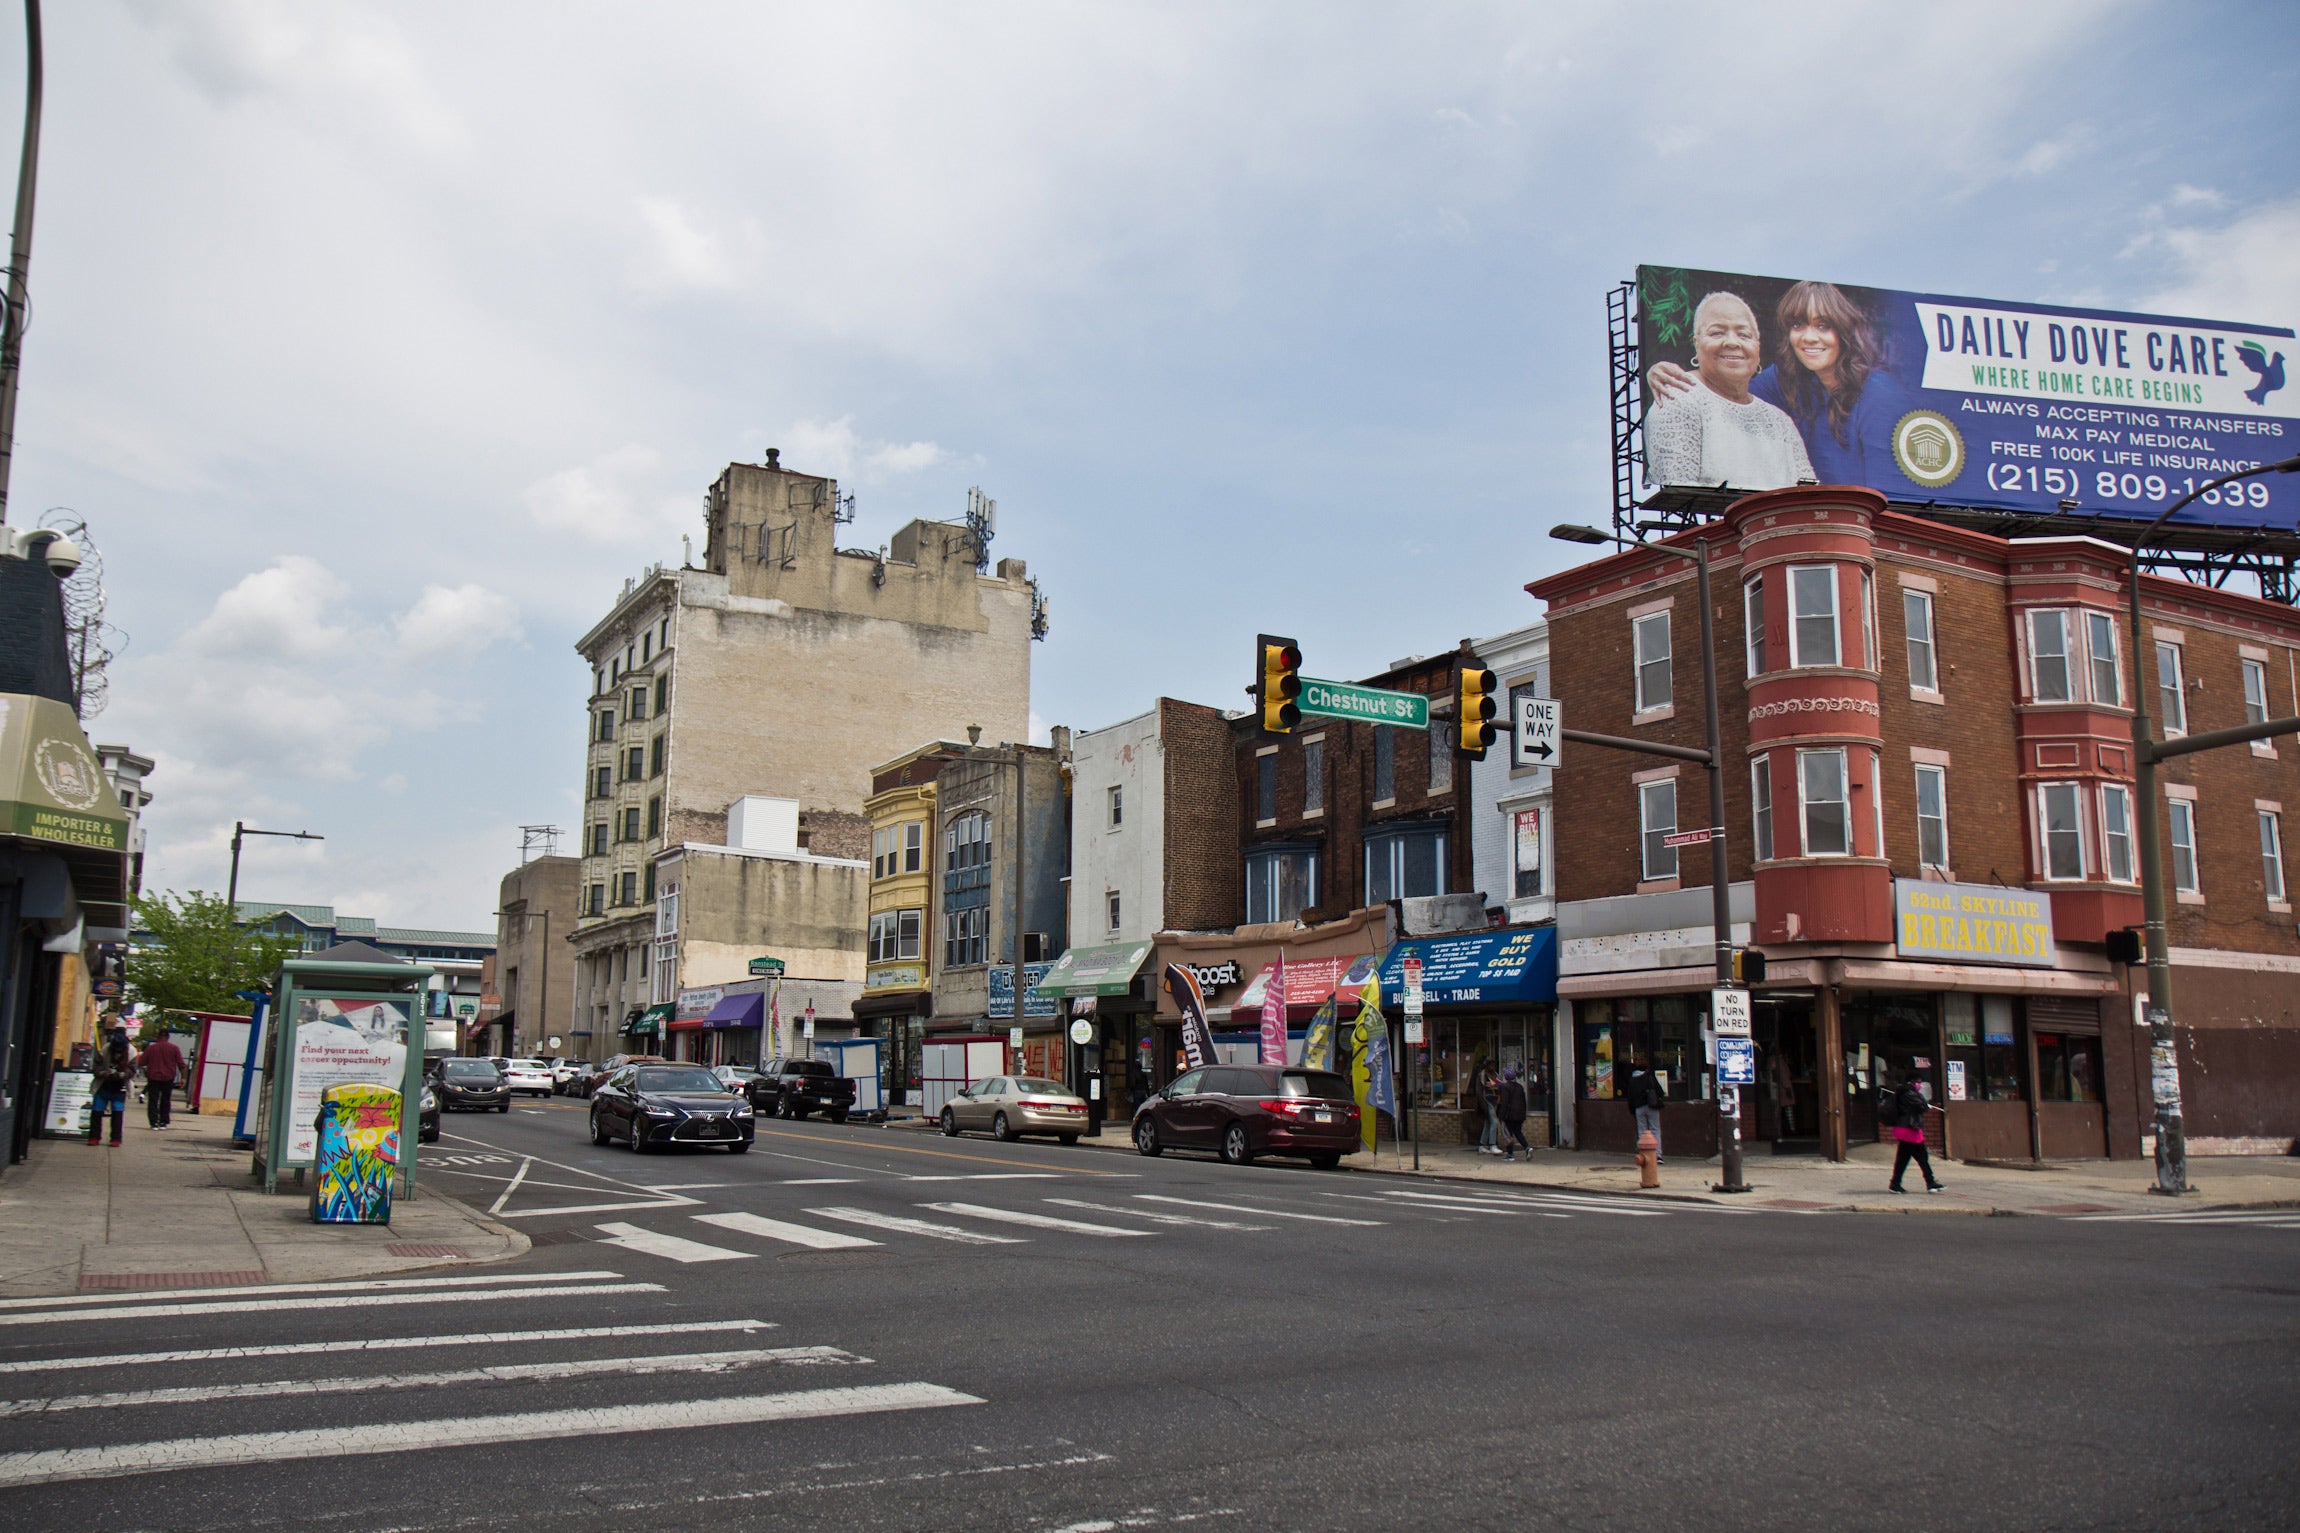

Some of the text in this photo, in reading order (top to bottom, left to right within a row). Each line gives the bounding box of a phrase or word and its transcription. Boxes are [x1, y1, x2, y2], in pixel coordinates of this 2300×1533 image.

[1937, 313, 2228, 376] DAILY DOVE CARE
[1972, 365, 2202, 404] WHERE HOME CARE BEGINS
[1961, 398, 2283, 437] ALWAYS ACCEPTING TRANSFERS
[2035, 425, 2215, 451] MAX PAY MEDICAL
[1991, 441, 2042, 458] FREE
[2050, 446, 2096, 462] 100K
[2103, 450, 2143, 466] LIFE
[1987, 462, 2270, 508] (215) 809-1639
[1307, 686, 1414, 719] Chestnut St
[1525, 704, 1554, 738] ONE WAY
[36, 812, 113, 834] IMPORTER &
[1520, 812, 1534, 822] WE
[31, 826, 115, 848] WHOLESALER
[1519, 824, 1537, 834] BUY
[1909, 891, 2040, 918] 52nd. SKYLINE
[1511, 934, 1534, 944] WE
[1903, 912, 2048, 957] BREAKFAST
[1499, 945, 1531, 955] BUY
[1189, 961, 1237, 985] boost
[1488, 957, 1526, 967] GOLD
[1393, 992, 1404, 1003] BU
[1452, 988, 1480, 1000] TRADE
[1726, 994, 1738, 1004] NO
[1720, 1007, 1744, 1016] TURN
[1716, 1018, 1748, 1029] ON RED
[301, 1045, 323, 1054] Find
[324, 1048, 346, 1056] your
[331, 1056, 391, 1066] opportunity!
[1947, 1062, 1963, 1073] ATM
